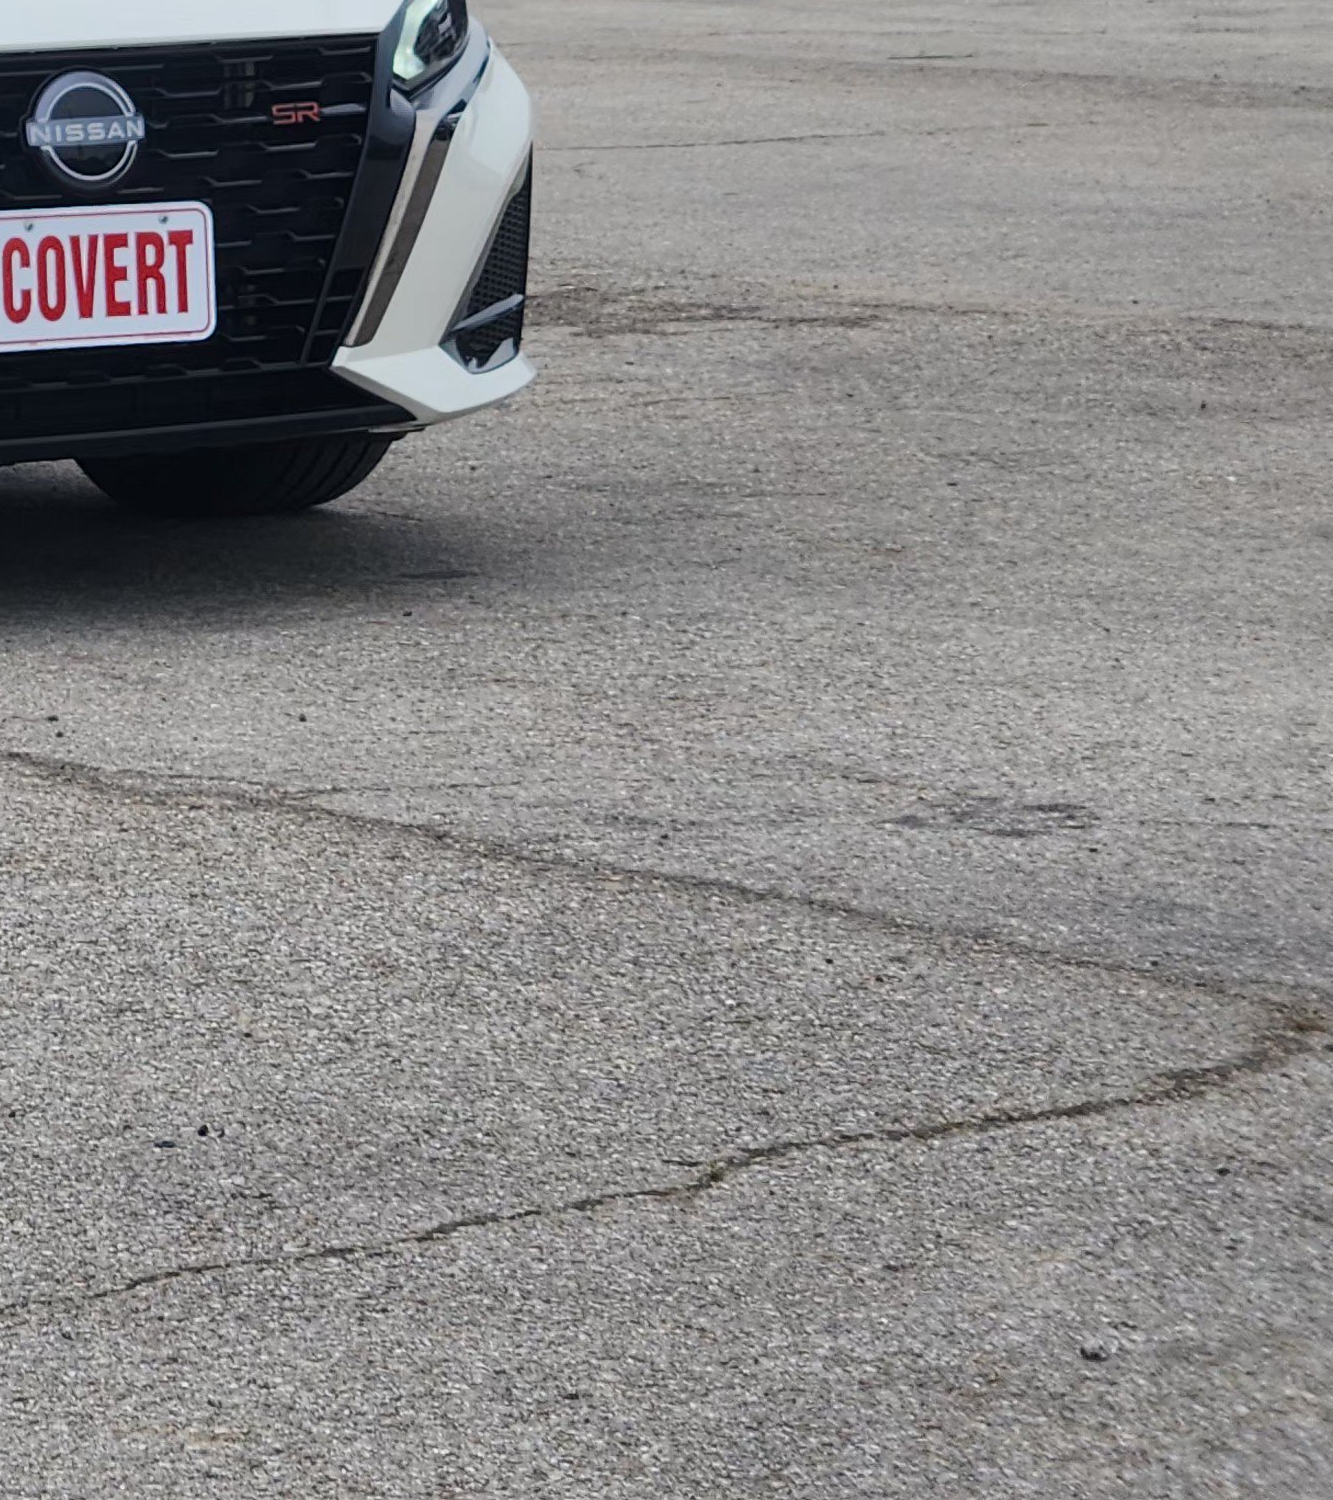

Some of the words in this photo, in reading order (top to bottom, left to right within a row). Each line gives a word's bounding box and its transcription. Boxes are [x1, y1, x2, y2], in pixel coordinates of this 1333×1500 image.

[271, 101, 320, 125] SR
[29, 119, 144, 143] NISSAN
[2, 229, 194, 324] COVERT
